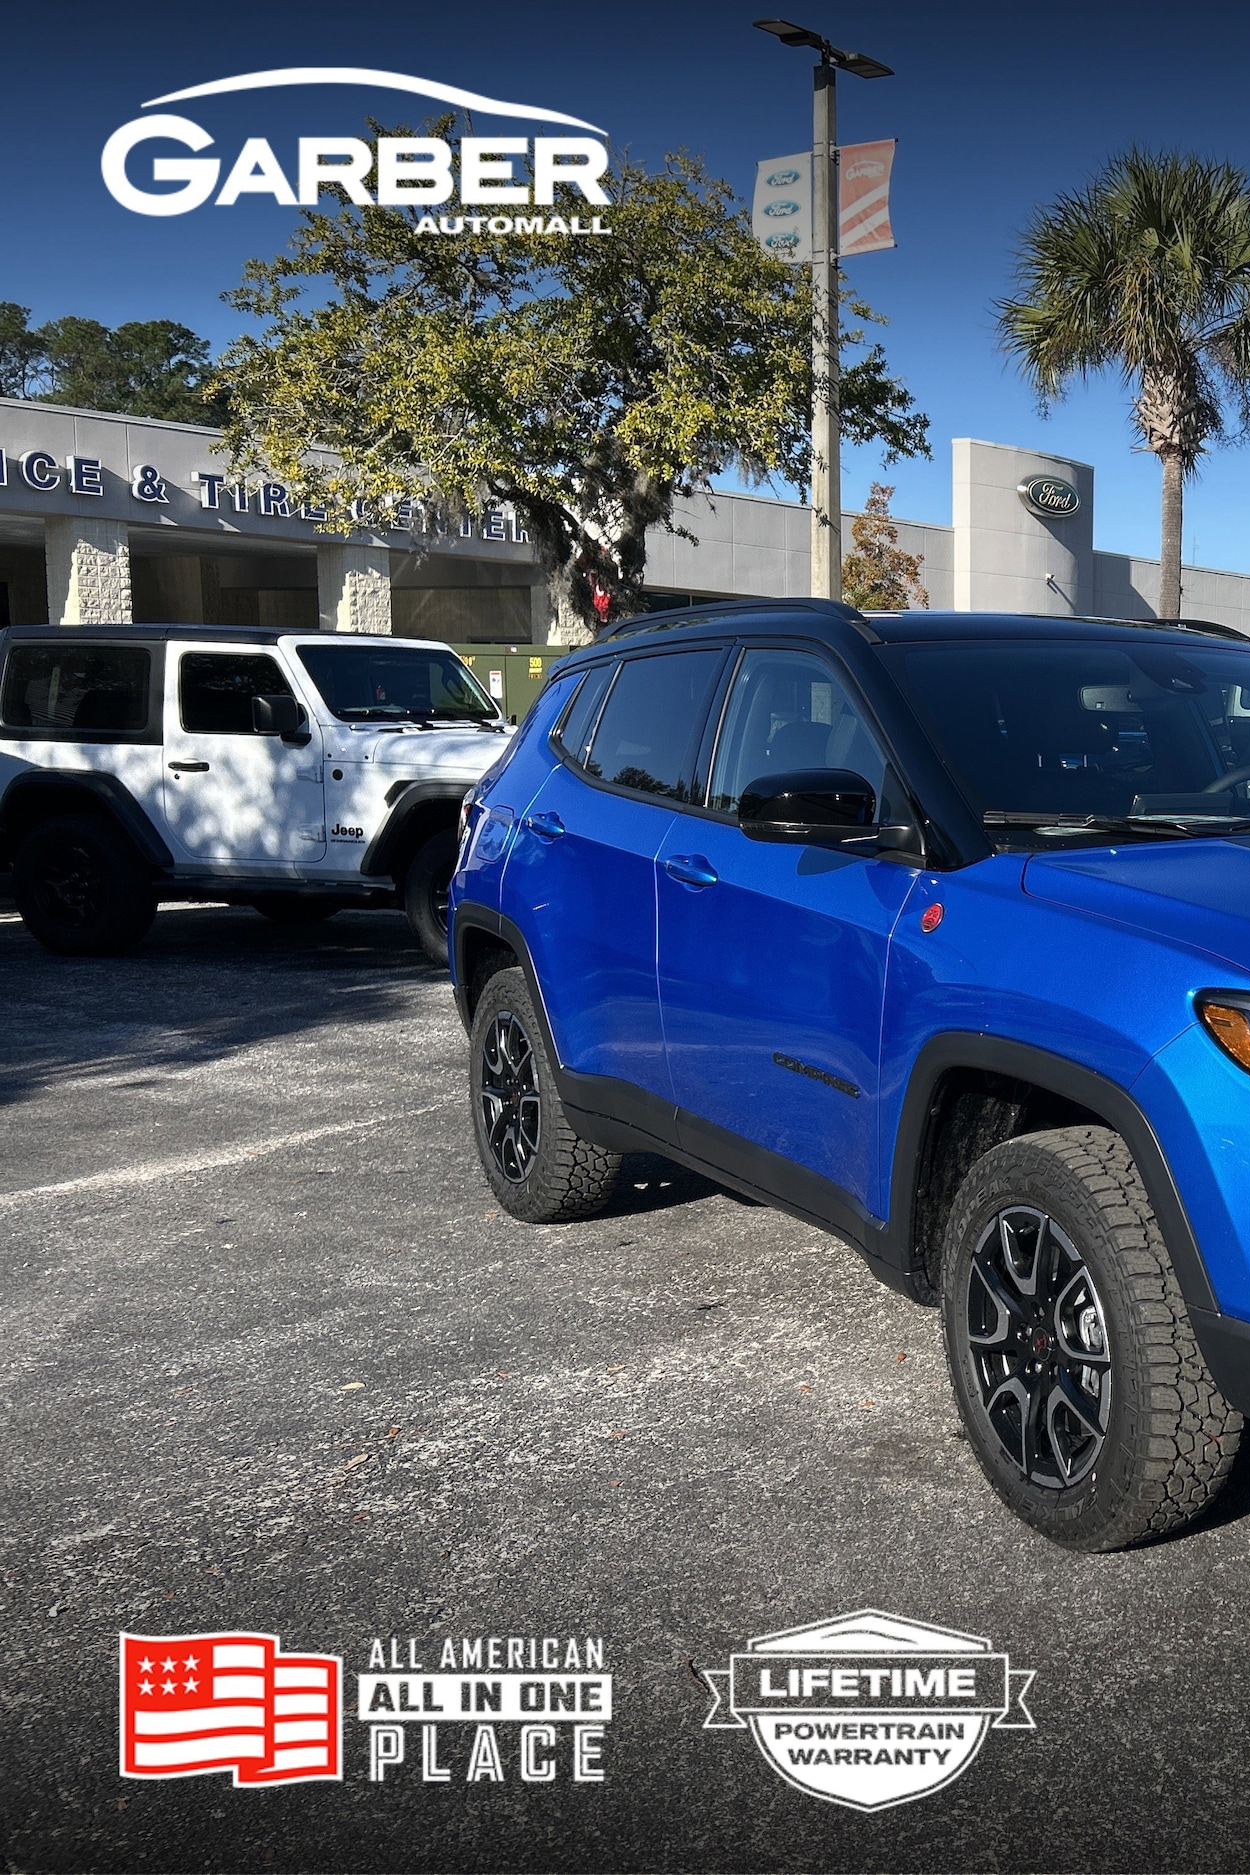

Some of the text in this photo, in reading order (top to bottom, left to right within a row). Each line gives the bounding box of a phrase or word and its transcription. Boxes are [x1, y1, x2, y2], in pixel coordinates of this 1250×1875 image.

[772, 171, 796, 186] Ford
[769, 202, 794, 216] Ford
[132, 464, 170, 504] &
[191, 471, 328, 522] TIRE
[1039, 482, 1072, 509] Ford
[331, 823, 364, 840] Jeep
